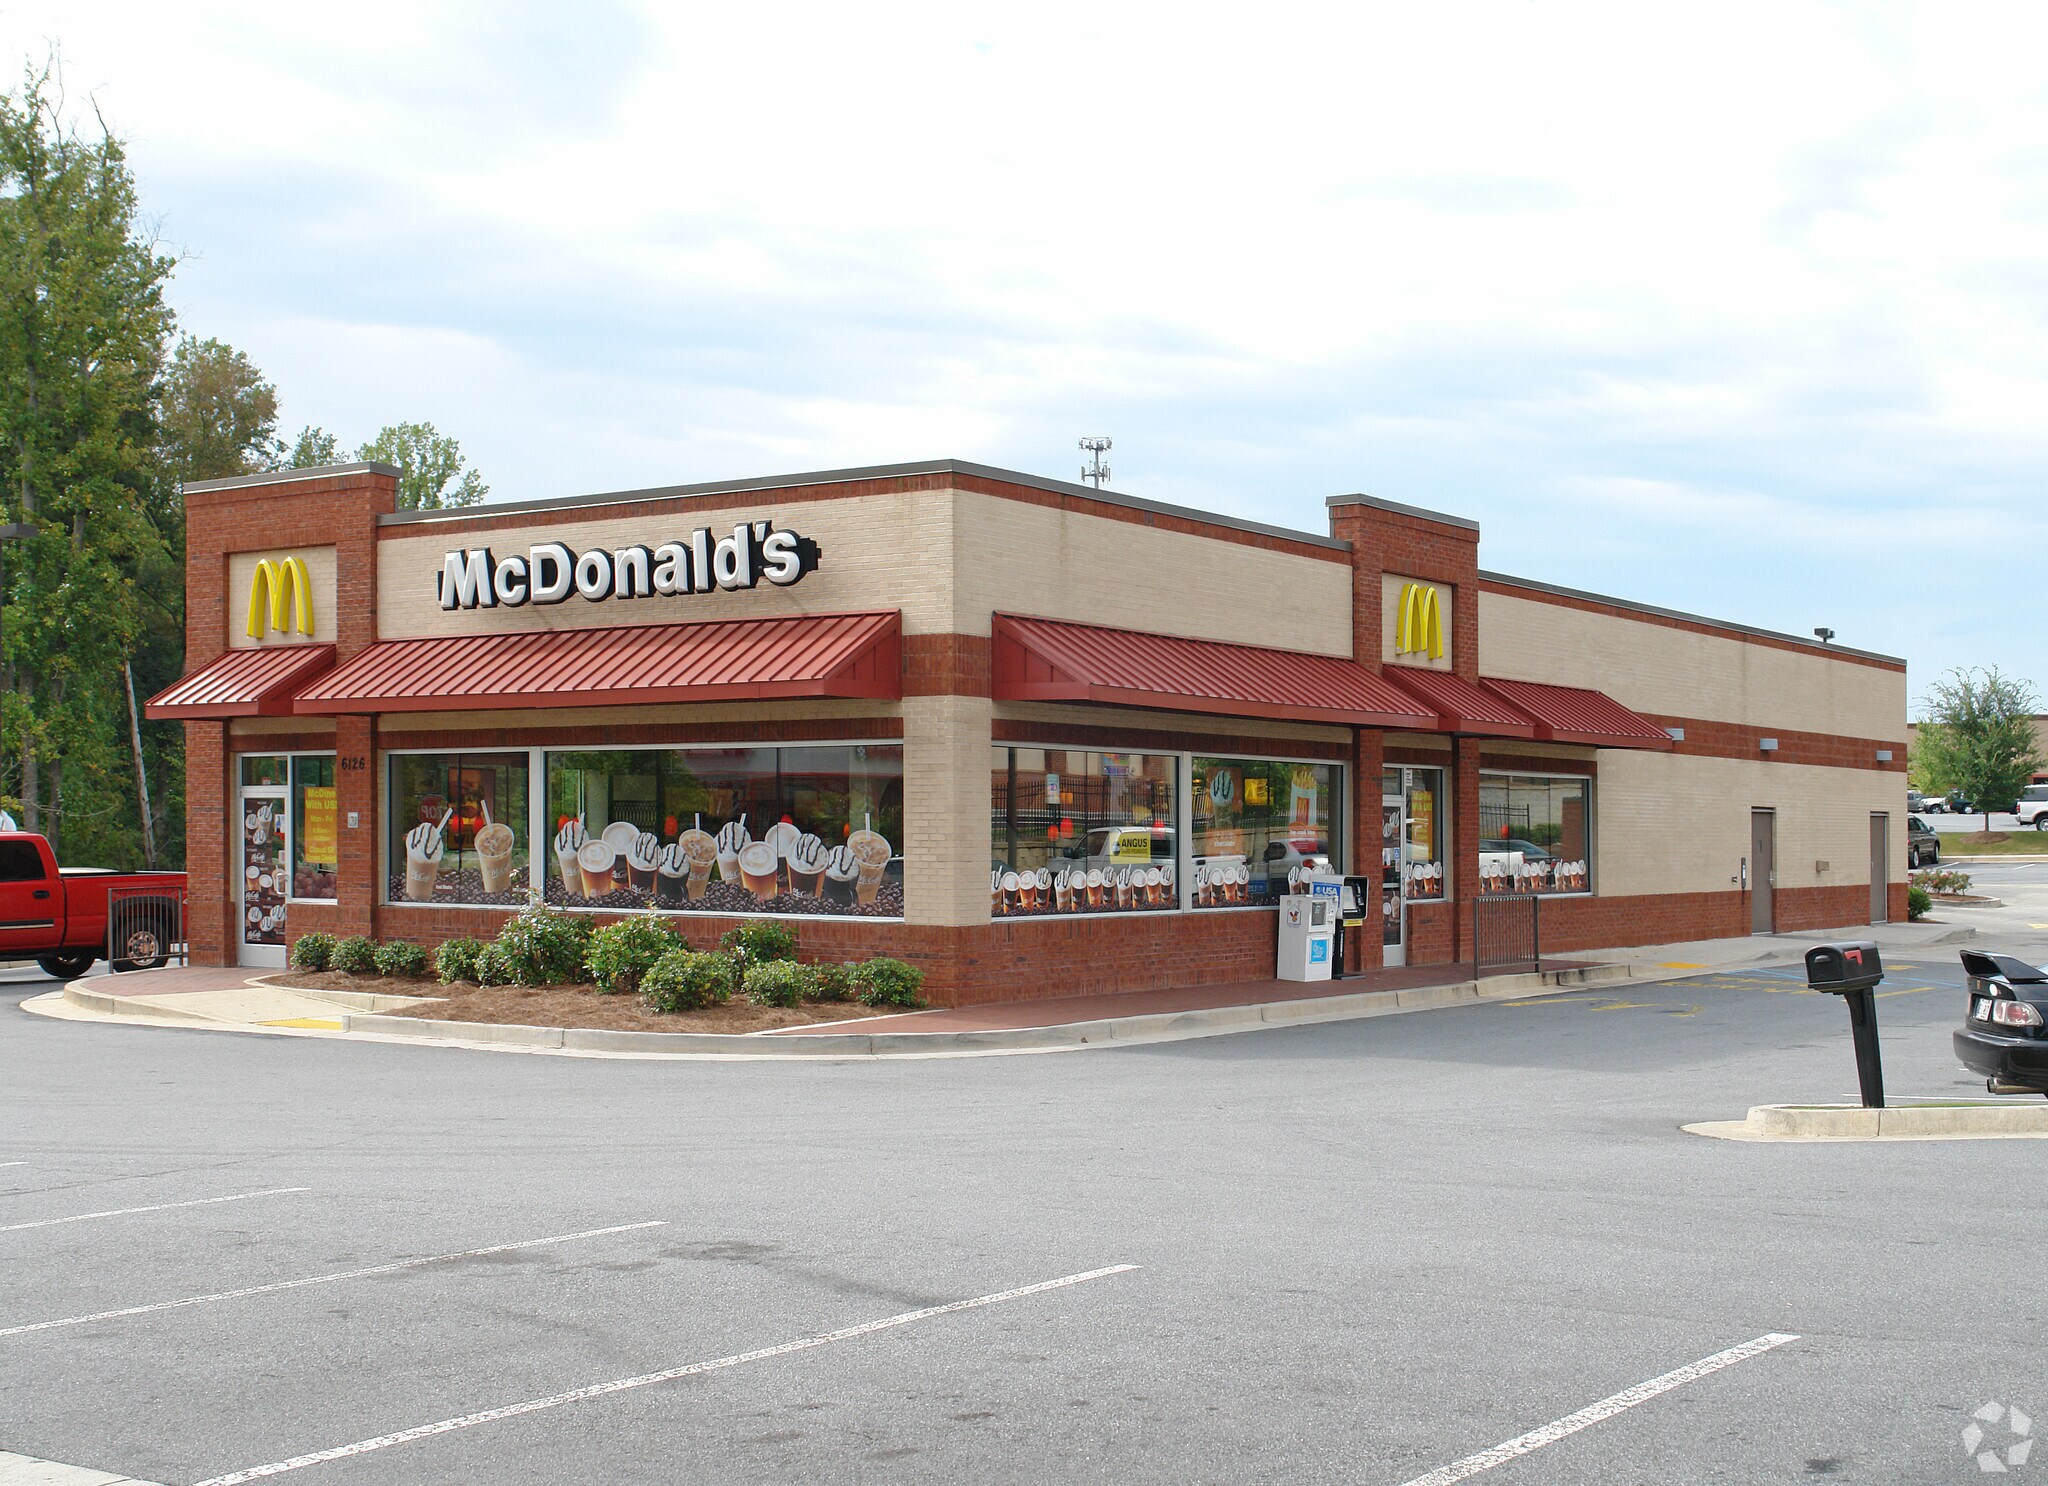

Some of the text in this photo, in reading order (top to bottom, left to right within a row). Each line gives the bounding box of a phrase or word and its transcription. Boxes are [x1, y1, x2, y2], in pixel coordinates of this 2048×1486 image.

[440, 521, 803, 611] McDonald's
[341, 757, 366, 770] 6126
[305, 799, 322, 809] With
[1121, 838, 1148, 848] ANGUS
[1322, 886, 1338, 896] USA
